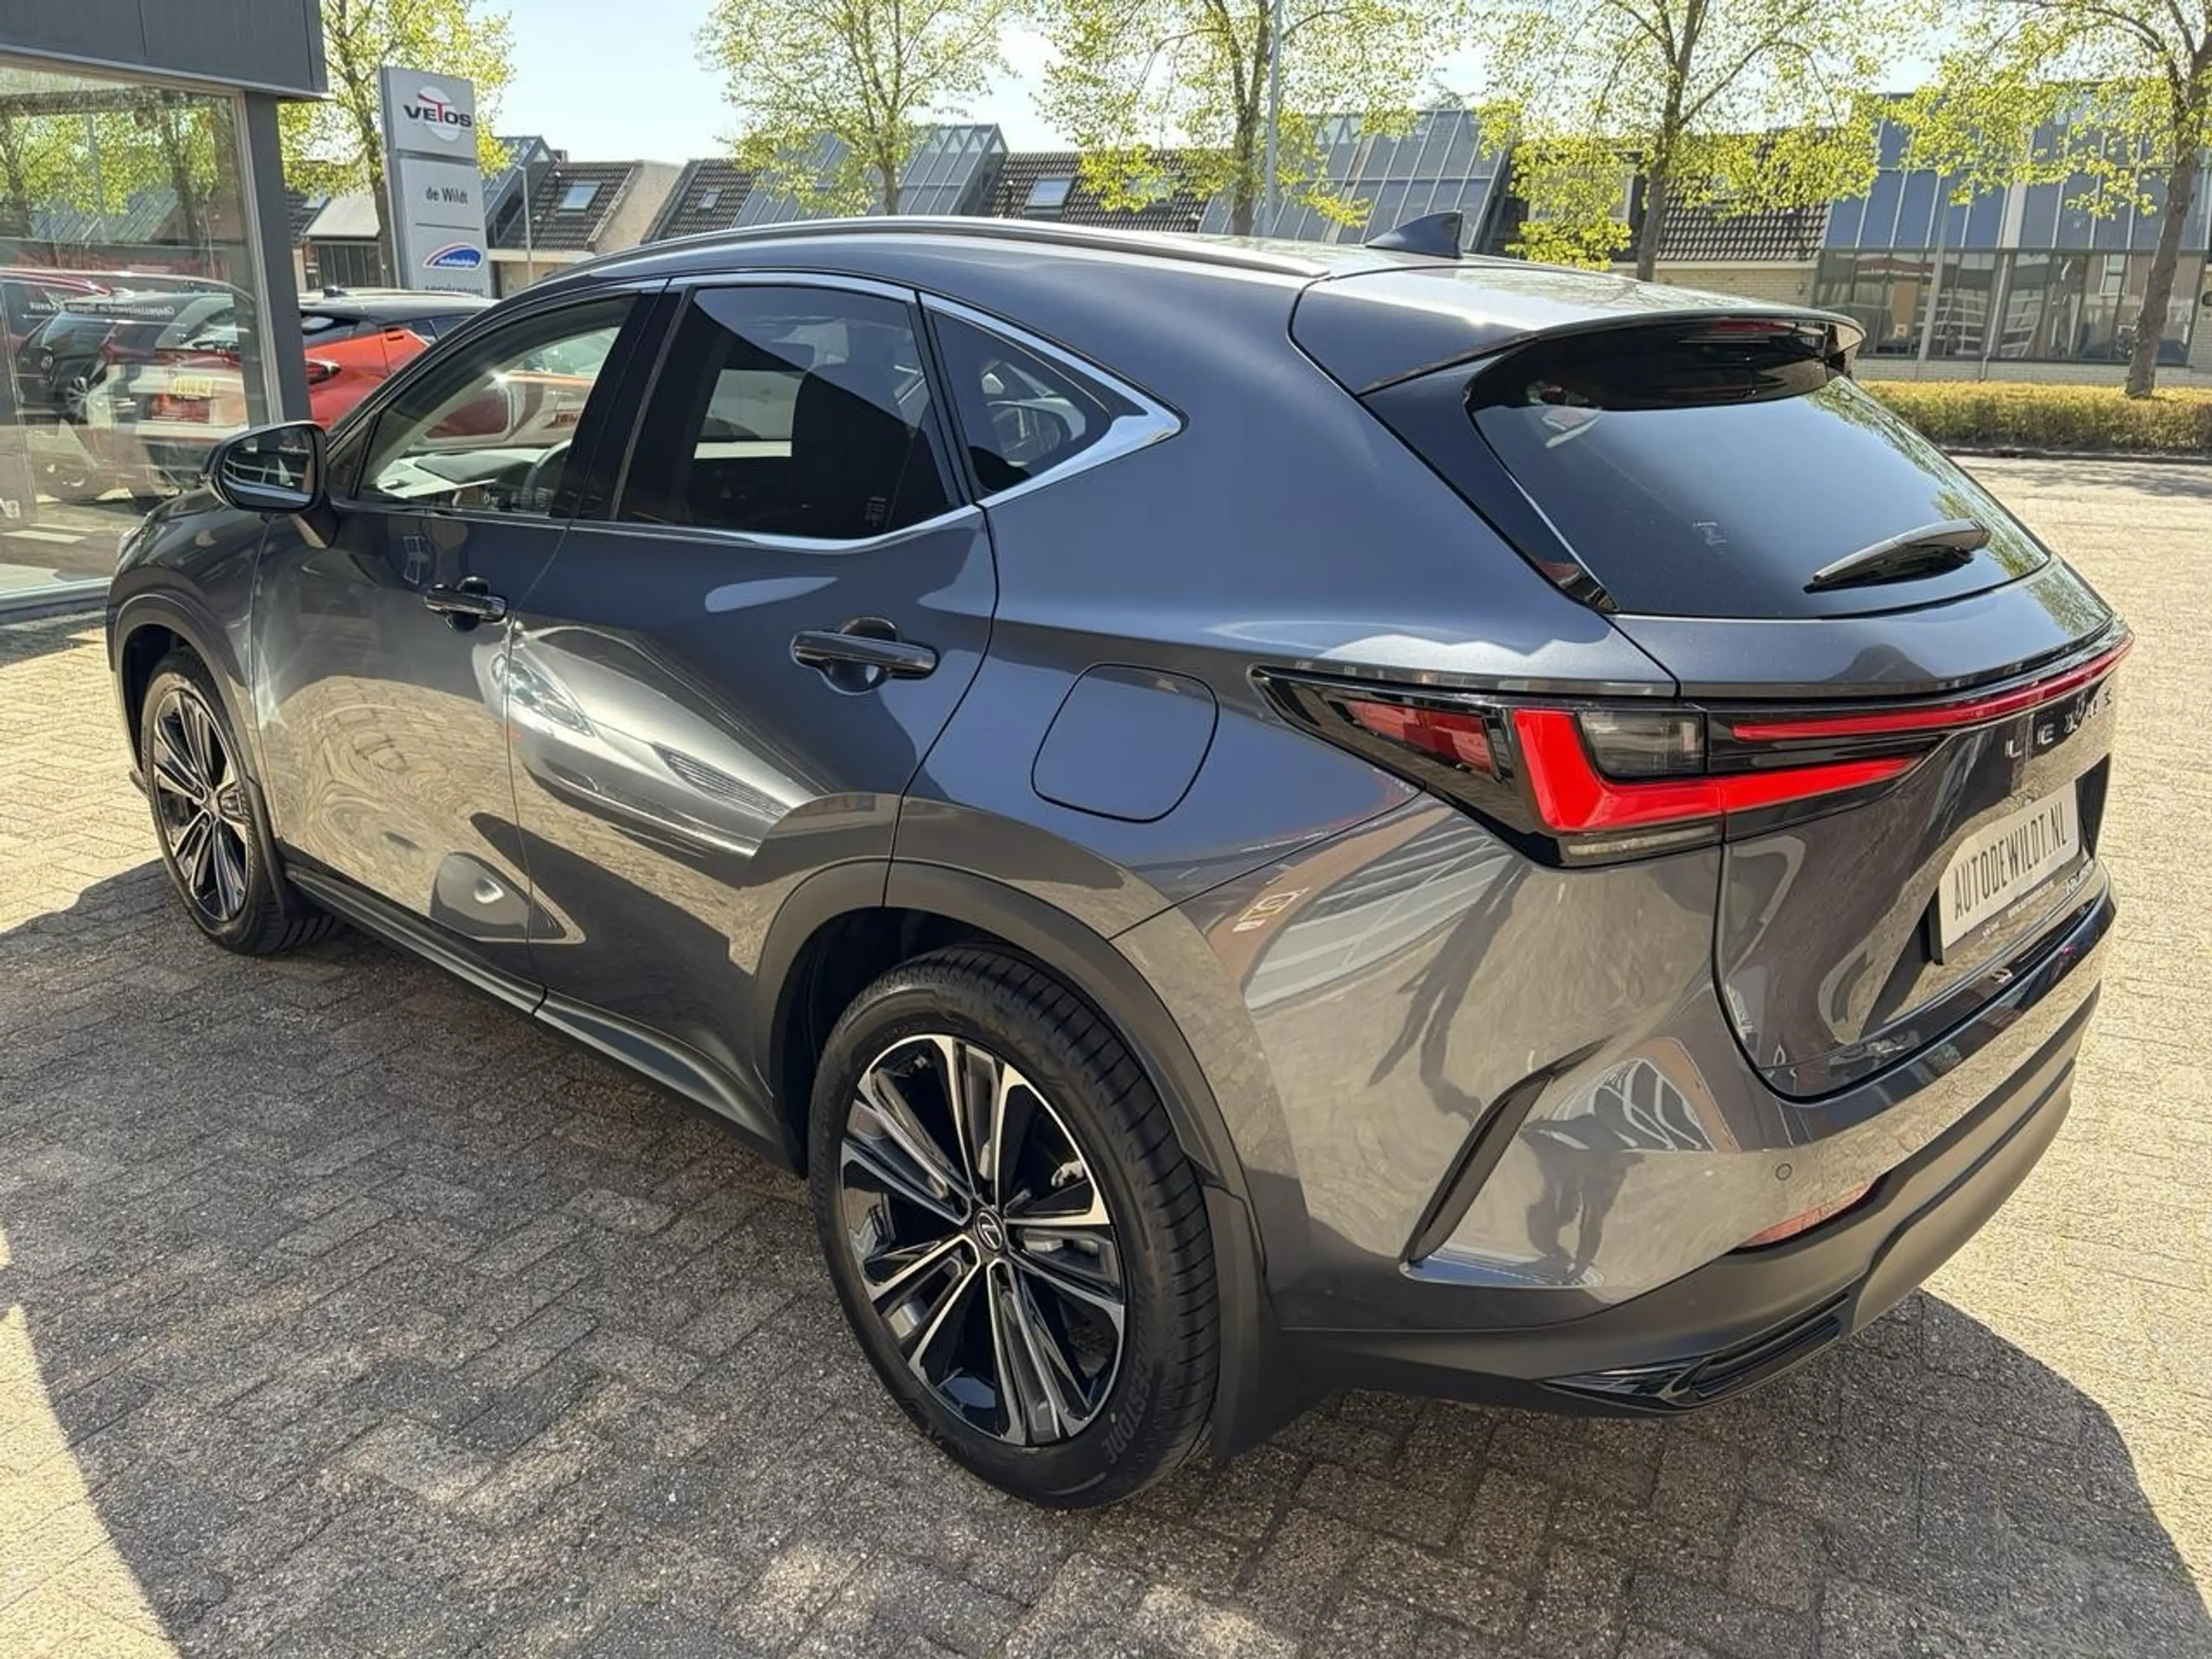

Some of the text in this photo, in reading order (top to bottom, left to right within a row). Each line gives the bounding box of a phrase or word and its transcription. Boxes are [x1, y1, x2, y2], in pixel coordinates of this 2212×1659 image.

[426, 187, 468, 203] de Wildt
[2005, 687, 2111, 758] LEXUS
[1955, 802, 2067, 921] AUTODEWILDT.NL
